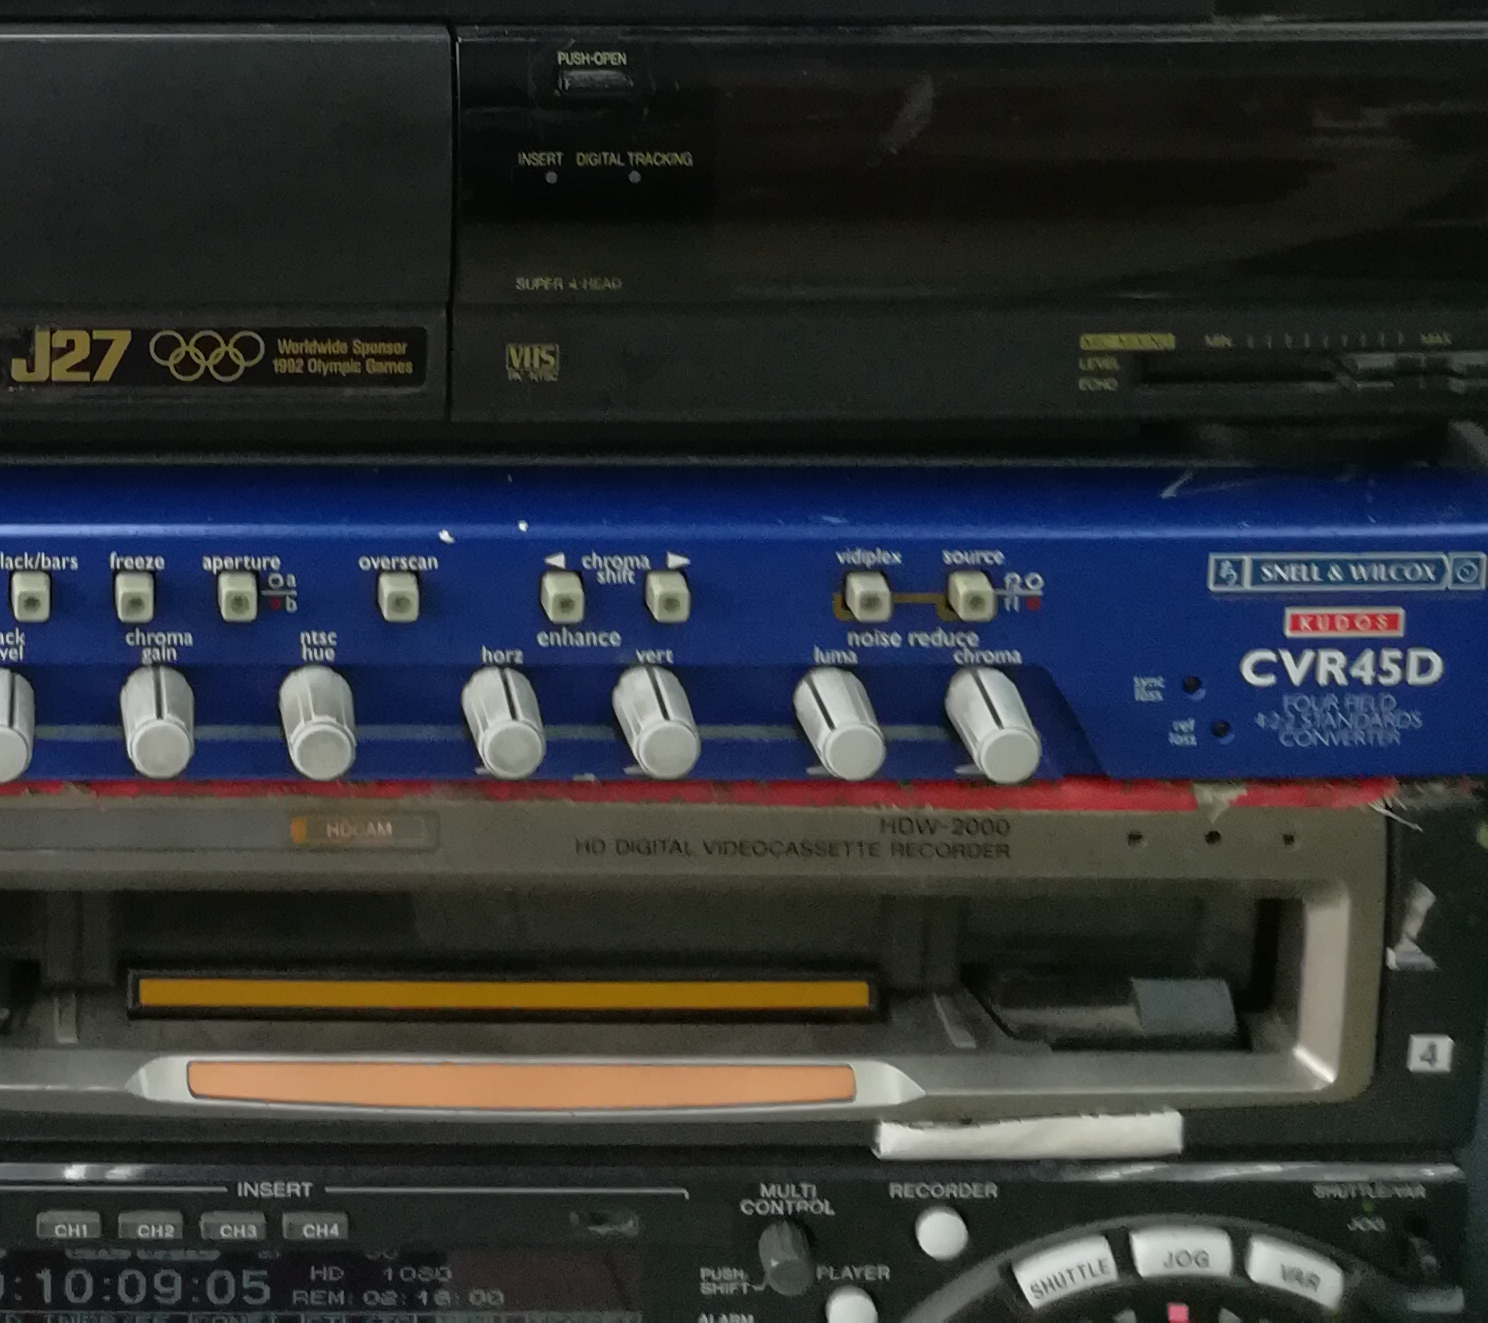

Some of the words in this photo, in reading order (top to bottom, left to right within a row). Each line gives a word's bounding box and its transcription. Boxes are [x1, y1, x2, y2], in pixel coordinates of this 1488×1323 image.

[517, 152, 565, 167] INSERT
[627, 152, 694, 167] TRACKING
[10, 328, 132, 383] J27
[109, 552, 165, 570] freeze
[202, 554, 281, 573] aperture
[358, 554, 439, 571] overscan
[580, 552, 651, 569] chroma
[835, 547, 902, 566] vidiplex
[942, 549, 1005, 566] source
[1260, 562, 1326, 583] SNELL
[1348, 562, 1438, 584] WILCOX
[1297, 612, 1389, 632] KUDOS
[125, 628, 194, 646] chroma
[299, 629, 337, 645] ntsc
[536, 628, 622, 647] enhance
[846, 628, 902, 648] noise
[907, 626, 980, 648] reduce
[480, 647, 524, 664] horz
[634, 647, 674, 664] vert
[1239, 648, 1444, 686] CVR45D
[879, 816, 1012, 836] HDW-2000
[574, 839, 607, 856] HD
[615, 840, 692, 856] DIGITAL
[702, 839, 881, 859] VIDEOCASSETTE
[889, 840, 1012, 859] RECORDER
[237, 1181, 313, 1198] INSERT
[759, 1182, 818, 1199] MULTI
[888, 1181, 999, 1199] RECORDER
[739, 1198, 836, 1216] CONTROL
[54, 1222, 89, 1238] CH1
[137, 1222, 176, 1238] CH2
[219, 1222, 257, 1238] CH3
[302, 1222, 341, 1238] CH4
[1162, 1249, 1211, 1269] JOG
[310, 1264, 345, 1282] HD
[815, 1264, 892, 1282] PLAYER
[1030, 1257, 1112, 1300] SHUTTLE
